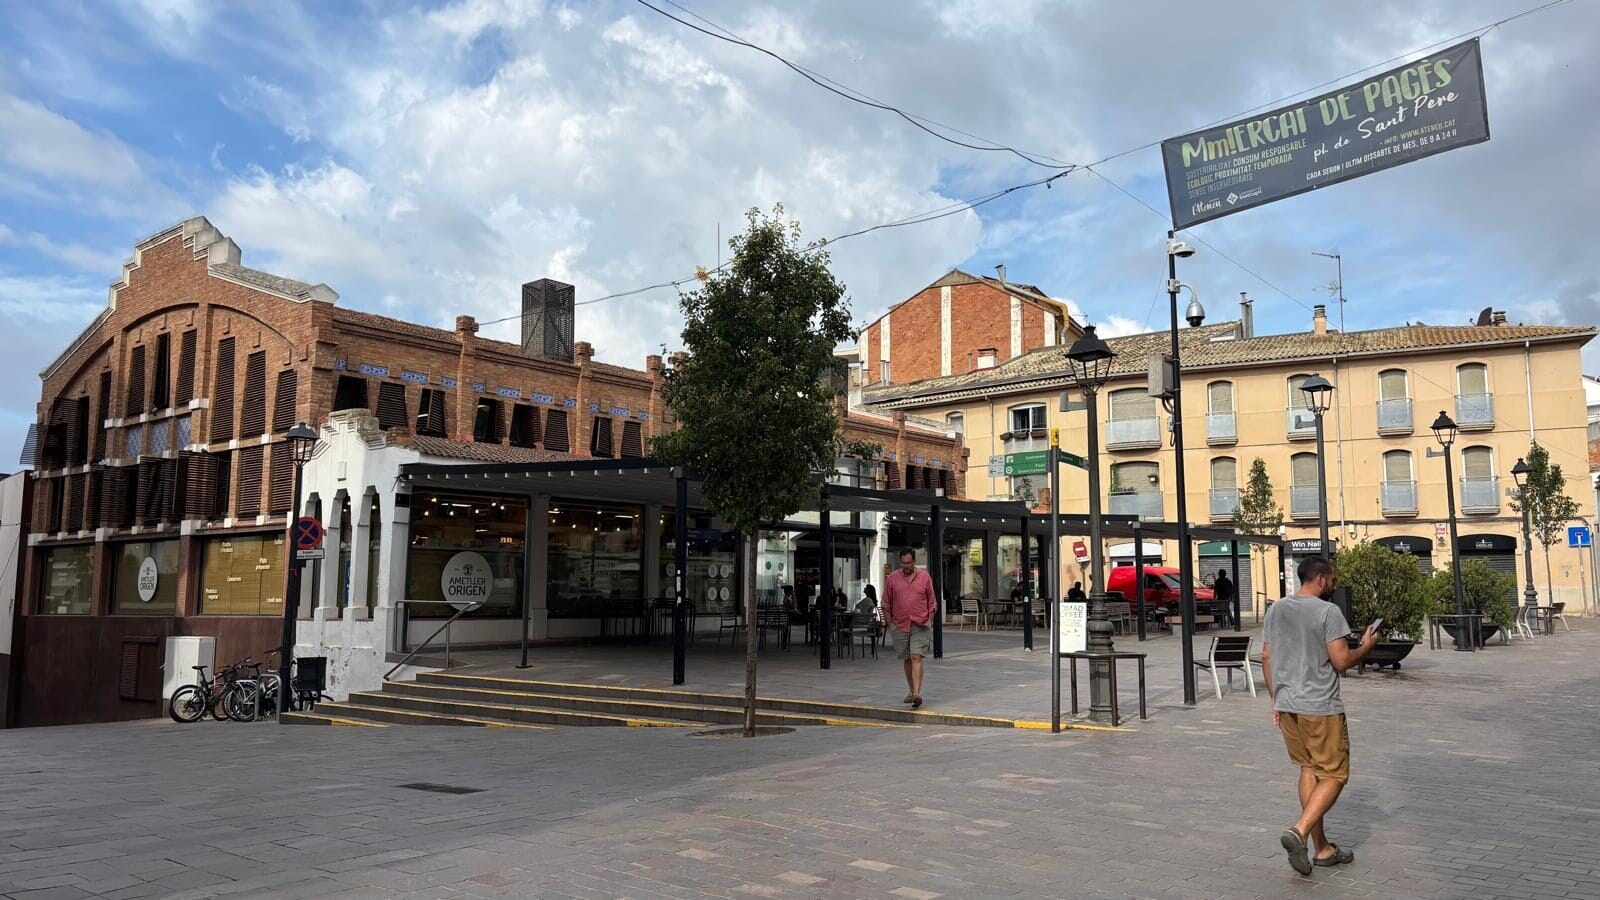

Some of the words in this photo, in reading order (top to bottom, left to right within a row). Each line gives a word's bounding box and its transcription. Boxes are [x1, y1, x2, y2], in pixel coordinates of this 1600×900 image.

[1319, 93, 1356, 126] DE
[1363, 59, 1452, 113] PAGÈS
[1334, 135, 1351, 150] de
[1357, 106, 1408, 139] Sant
[1414, 91, 1459, 117] Pere
[1215, 164, 1251, 181] PROXIMITAT
[1253, 153, 1292, 171] TEMPORADA
[1233, 152, 1260, 167] CONSUM
[1261, 138, 1307, 158] RESPONSABLE
[1306, 170, 1321, 180] CADA
[1322, 164, 1340, 176] SEGON
[1363, 147, 1391, 162] DISSABTE
[1393, 144, 1401, 153] DE
[1420, 136, 1429, 146] DE
[1430, 135, 1435, 143] 9
[448, 585, 486, 596] ORIGEN
[449, 576, 486, 585] AMETLLER
